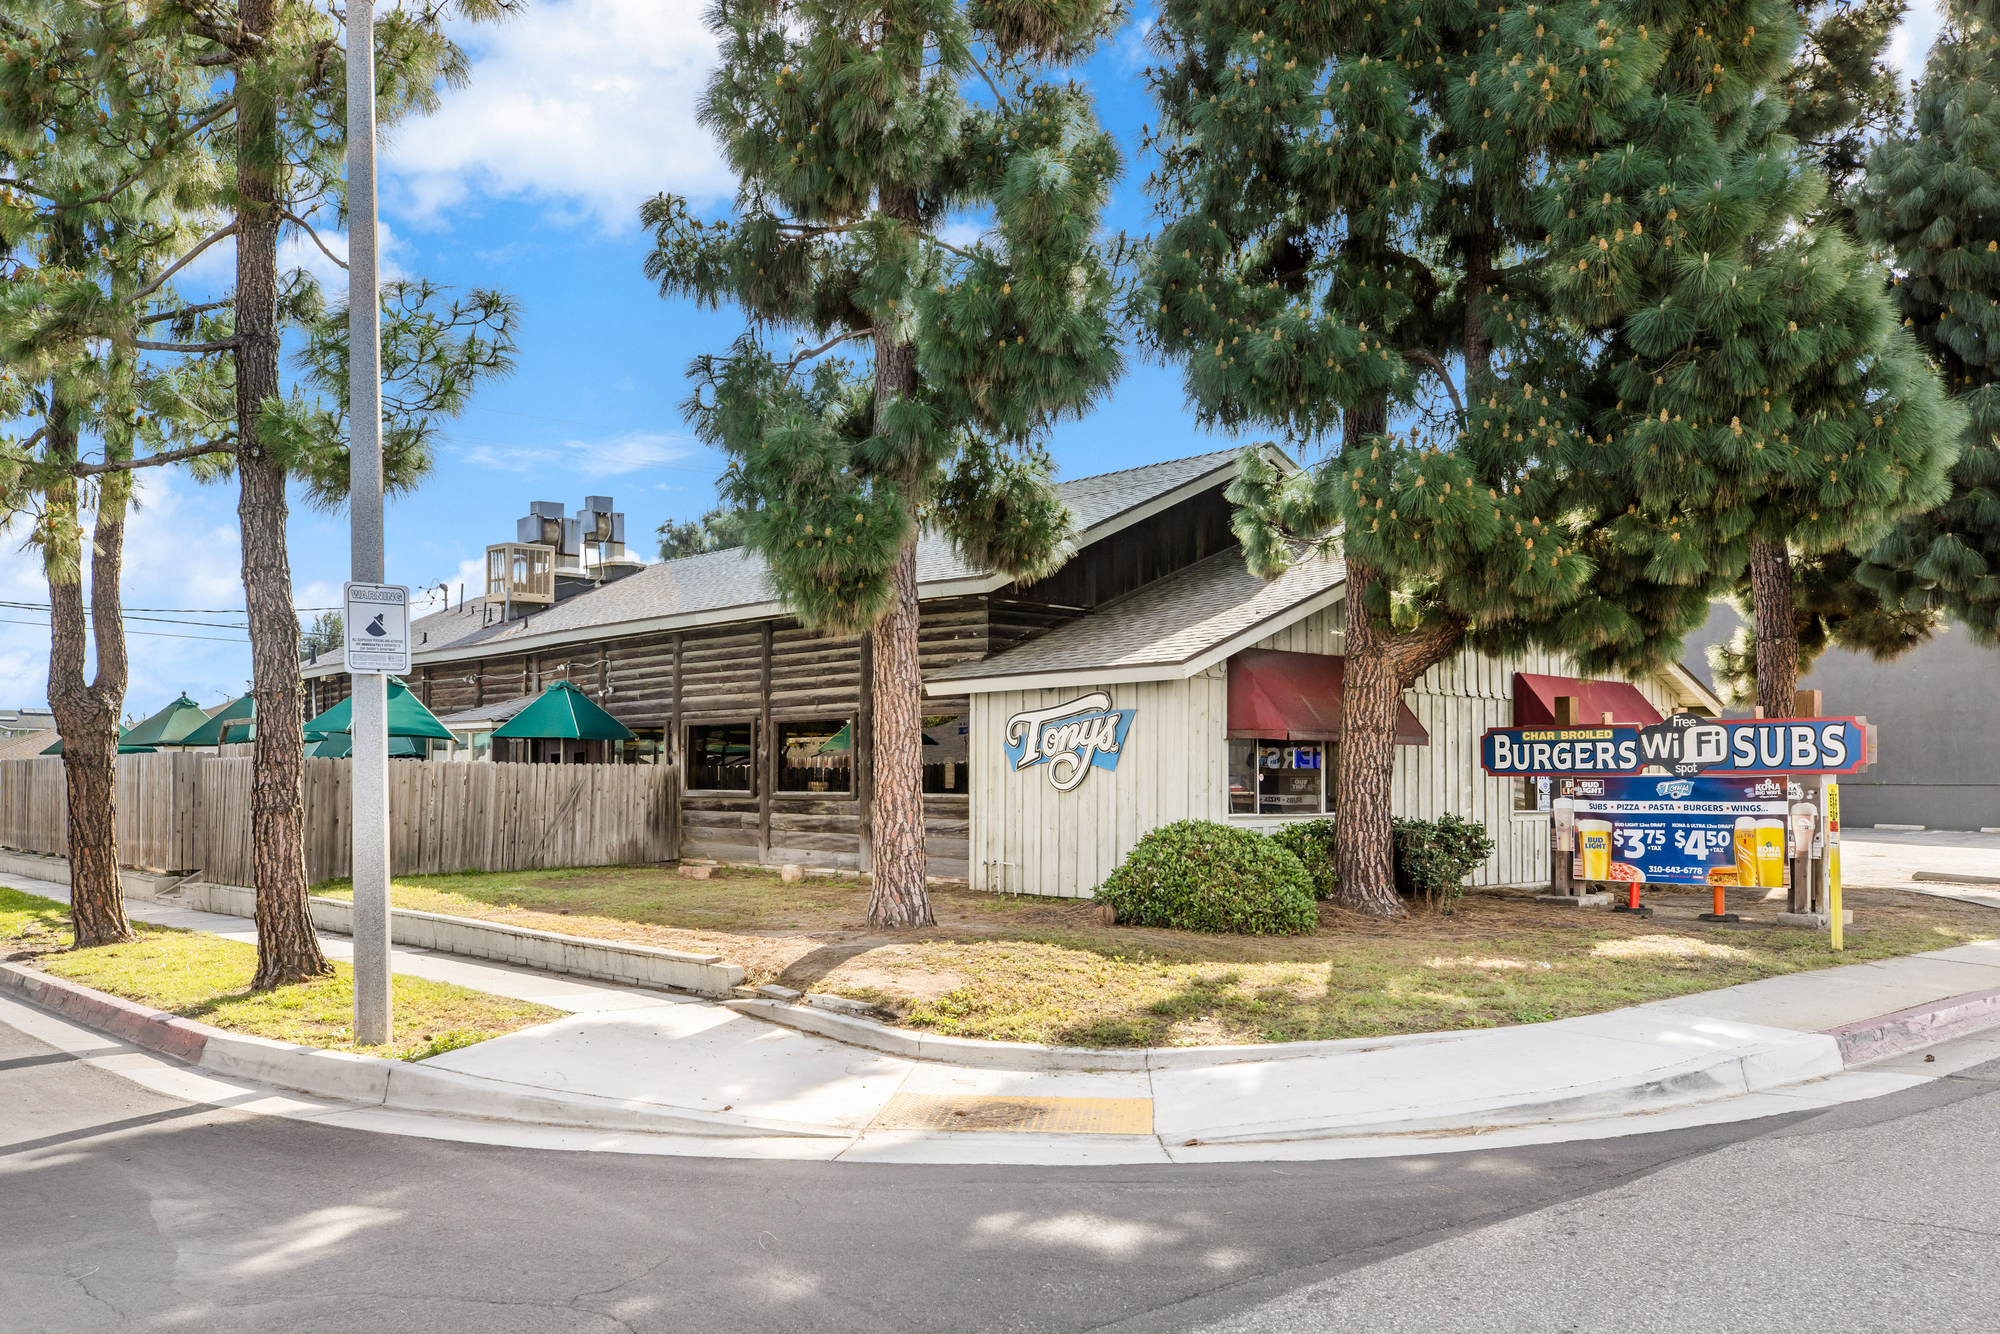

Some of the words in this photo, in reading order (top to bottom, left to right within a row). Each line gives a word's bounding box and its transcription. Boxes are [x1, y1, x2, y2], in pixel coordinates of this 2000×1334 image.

[351, 589, 402, 602] WARNING
[1673, 715, 1697, 727] Free
[1522, 731, 1555, 741] CHAR
[1560, 730, 1613, 740] BROILED
[1493, 734, 1637, 770] BURGERS
[1732, 722, 1848, 769] SUBS
[1675, 762, 1698, 775] spot
[1648, 865, 1703, 874] 310-643-6778
